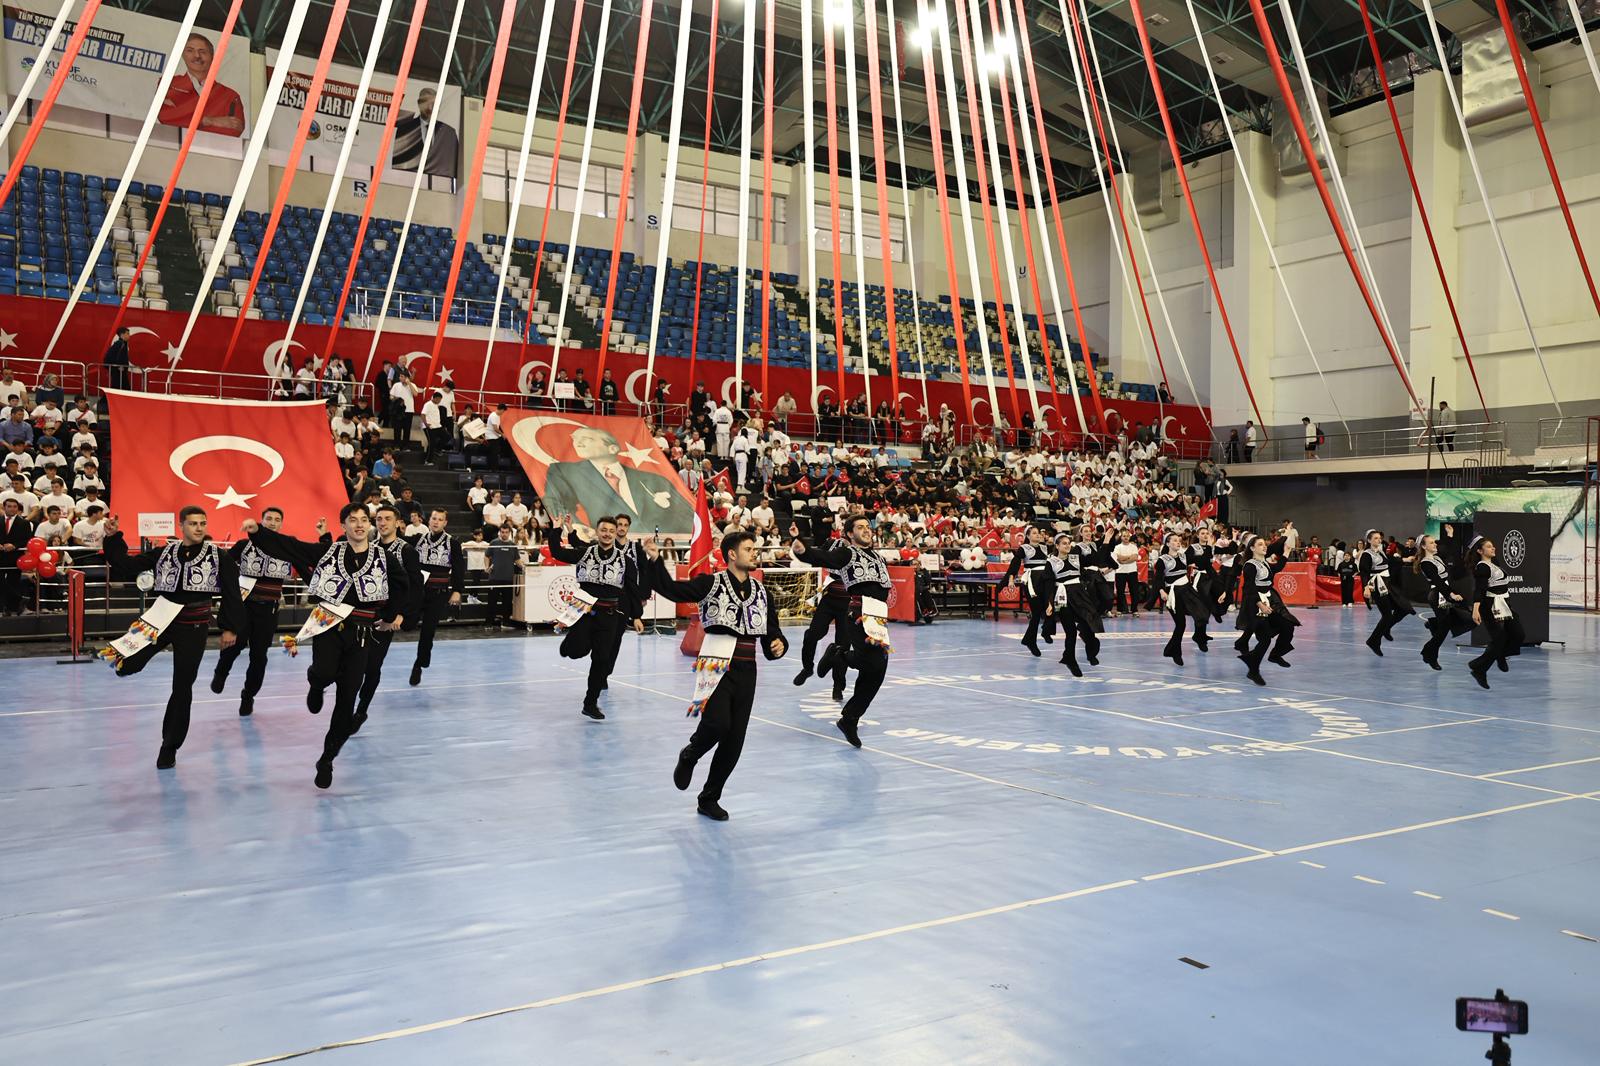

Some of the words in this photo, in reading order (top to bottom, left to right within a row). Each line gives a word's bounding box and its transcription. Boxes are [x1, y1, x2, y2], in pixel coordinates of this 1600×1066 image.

[46, 60, 80, 73] YUUF
[45, 69, 97, 86] ALMDAR
[278, 87, 342, 115] AŞALAR
[353, 180, 368, 193] R
[647, 214, 658, 225] S
